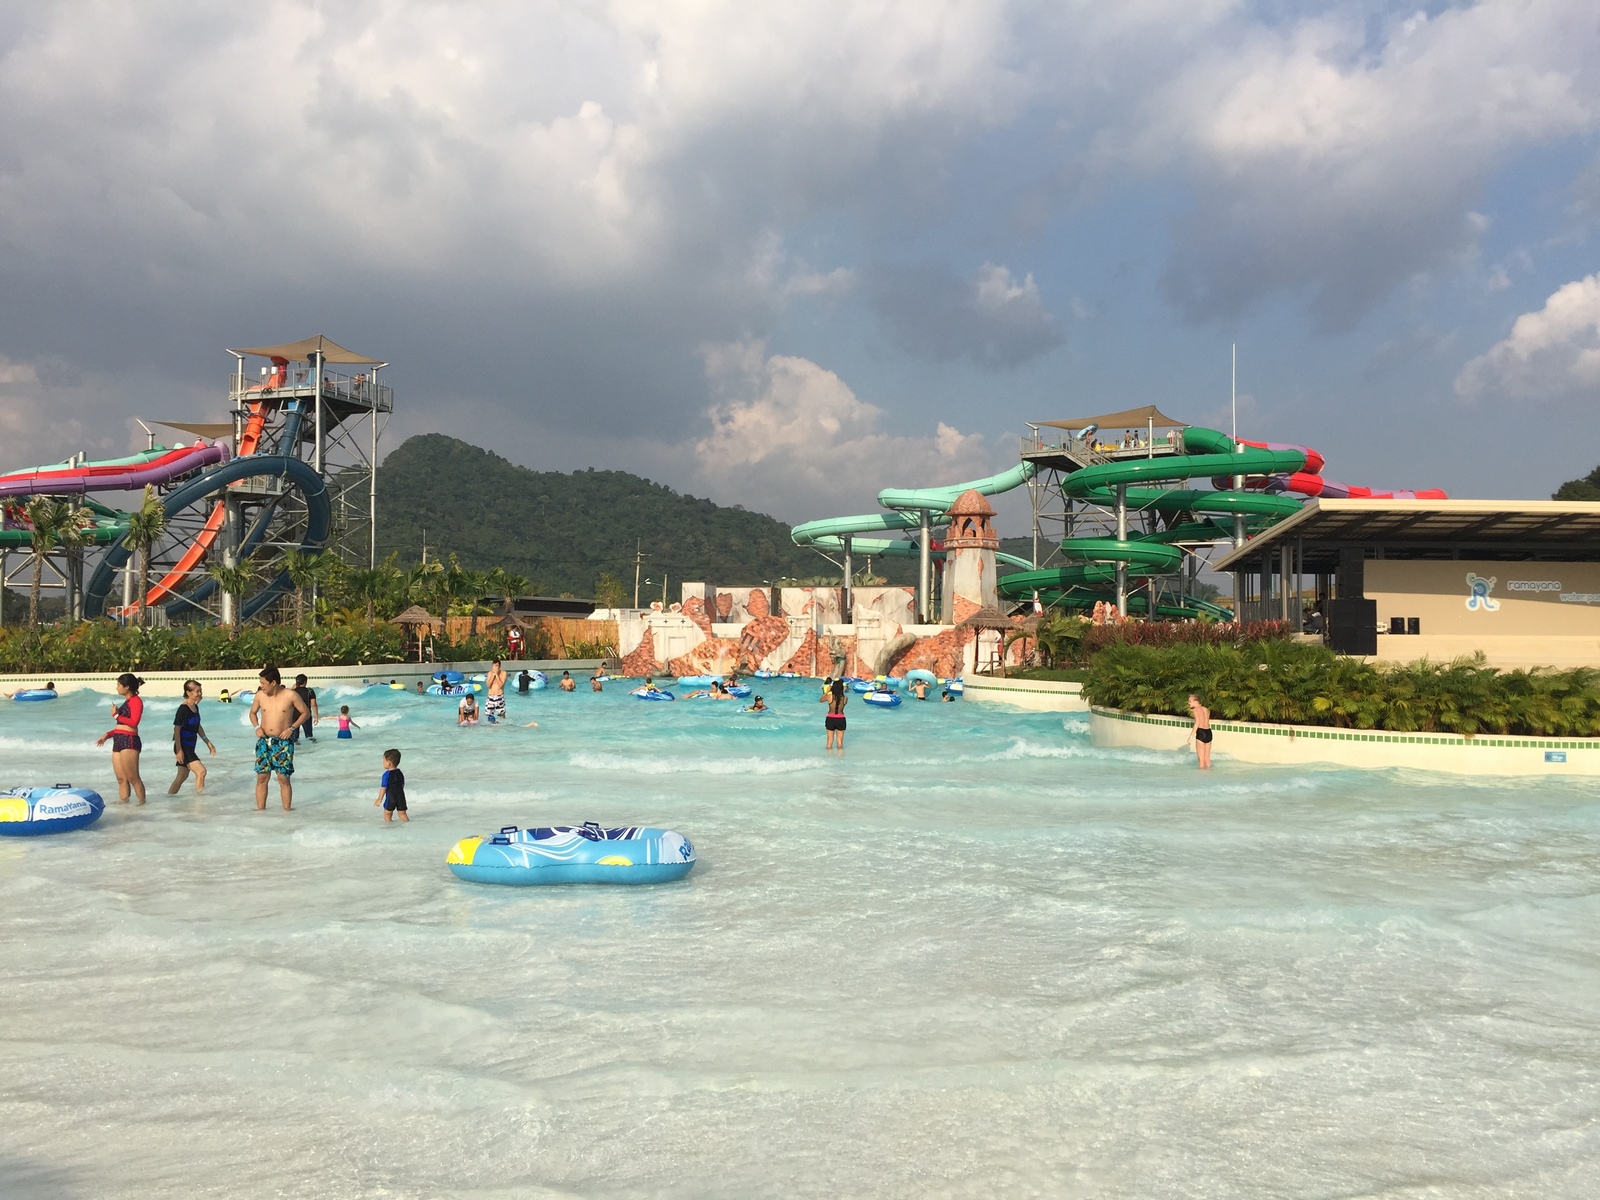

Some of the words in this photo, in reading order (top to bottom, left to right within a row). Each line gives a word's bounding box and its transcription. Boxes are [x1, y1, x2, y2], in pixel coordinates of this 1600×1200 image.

[1508, 581, 1561, 592] ramayana
[1560, 592, 1585, 601] water
[39, 802, 87, 815] RamaYana
